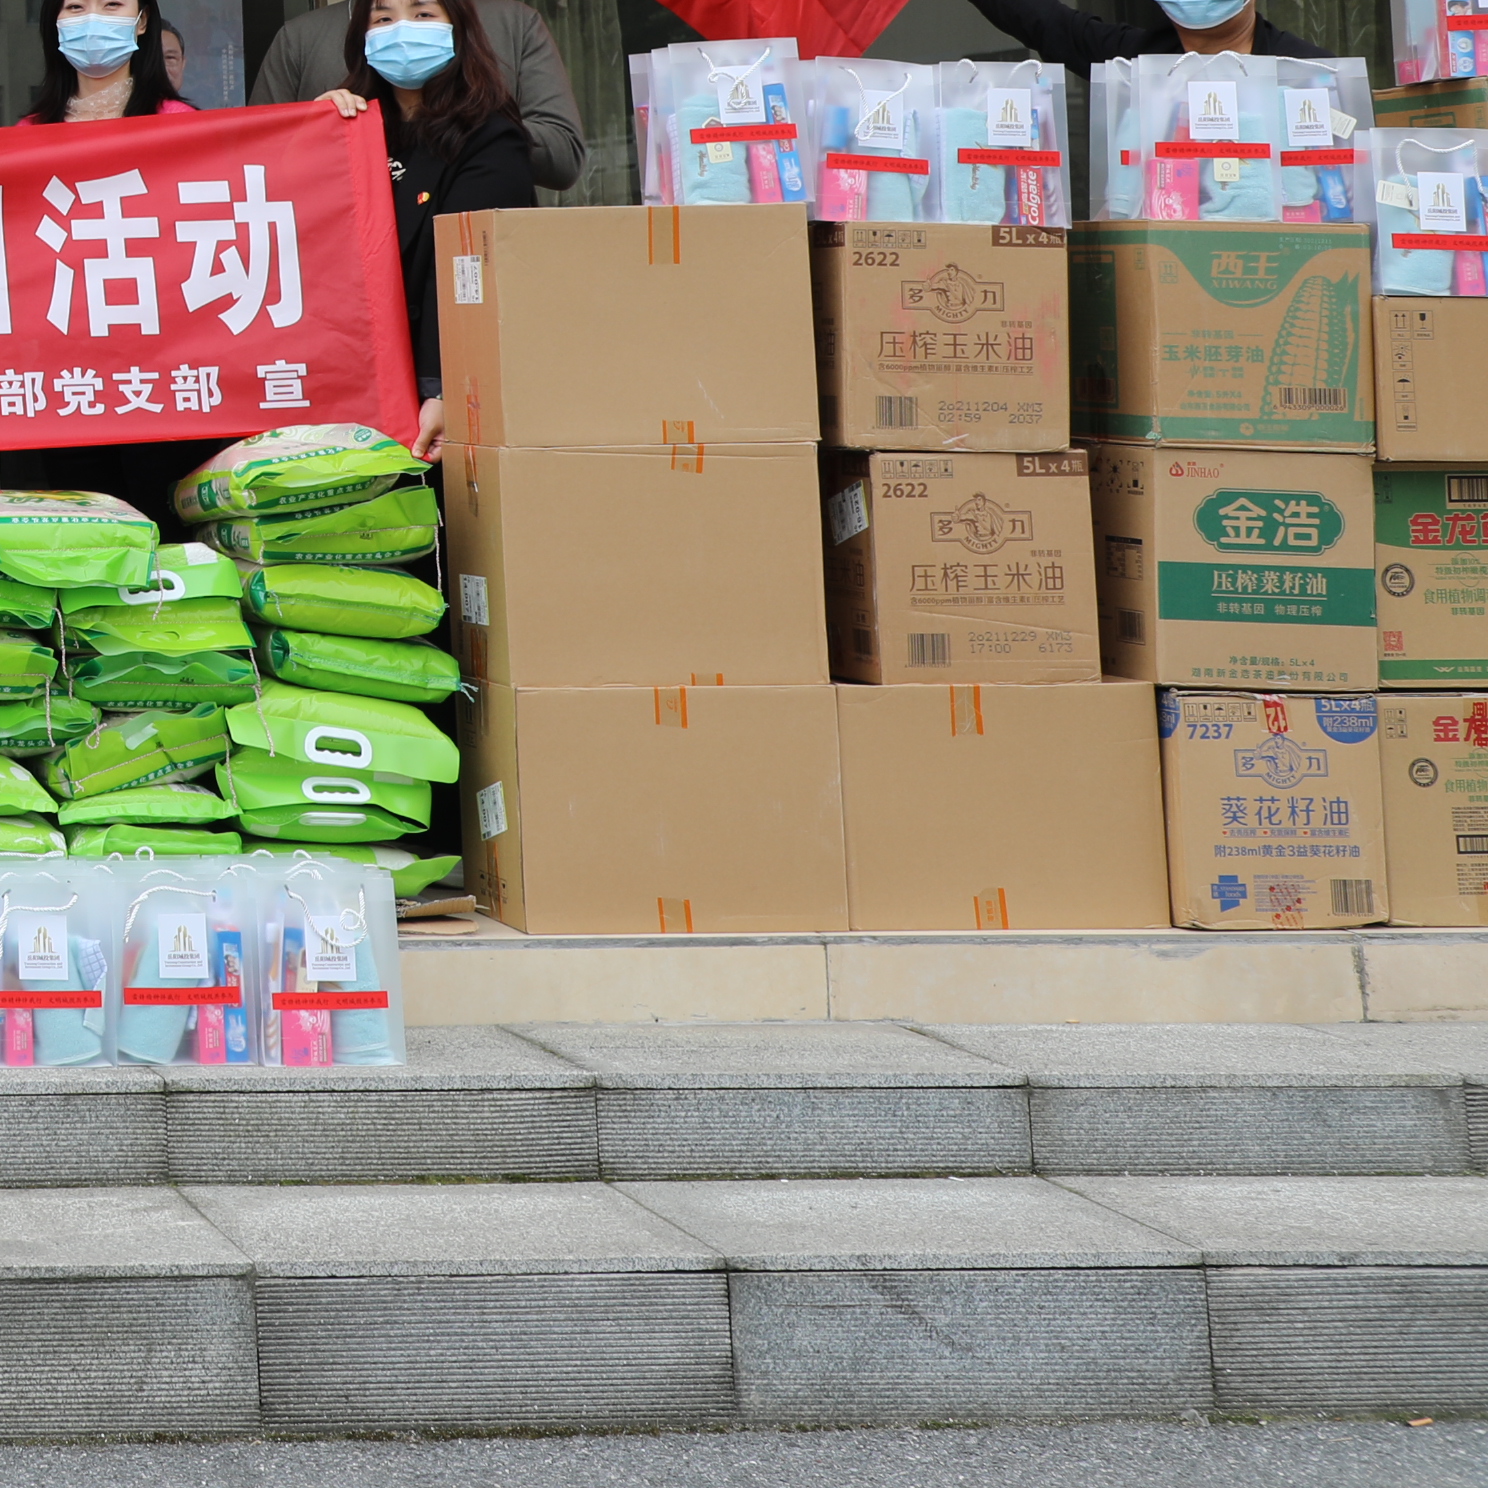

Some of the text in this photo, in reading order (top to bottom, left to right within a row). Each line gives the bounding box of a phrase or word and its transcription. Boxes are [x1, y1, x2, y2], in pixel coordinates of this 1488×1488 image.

[852, 252, 900, 267] 2622
[1210, 250, 1282, 279] 西王
[1211, 279, 1278, 290] XIWANG
[934, 304, 970, 319] MIGHTY
[878, 330, 1033, 362] 压榨玉米油
[1161, 344, 1265, 363] 玉米胚芽油
[257, 360, 311, 412] 宣
[1017, 402, 1043, 413] XM3
[938, 412, 1043, 424] 02:59 2037
[1186, 465, 1219, 479] JINHAO
[881, 482, 928, 498] 2622
[1218, 497, 1320, 546] 金浩
[964, 535, 999, 550] MIGHTY
[909, 561, 1065, 592] 压榨玉米油
[1212, 570, 1327, 595] 压榨菜籽油
[1217, 602, 1322, 617] 非转基因 物理压榨
[1046, 630, 1072, 642] XM3
[970, 642, 1073, 654] 17:00 6173
[1323, 715, 1373, 728] 附238ml
[1187, 724, 1233, 740] 7237
[1265, 771, 1297, 786] MIGHTY
[1220, 796, 1350, 827] 葵花籽油
